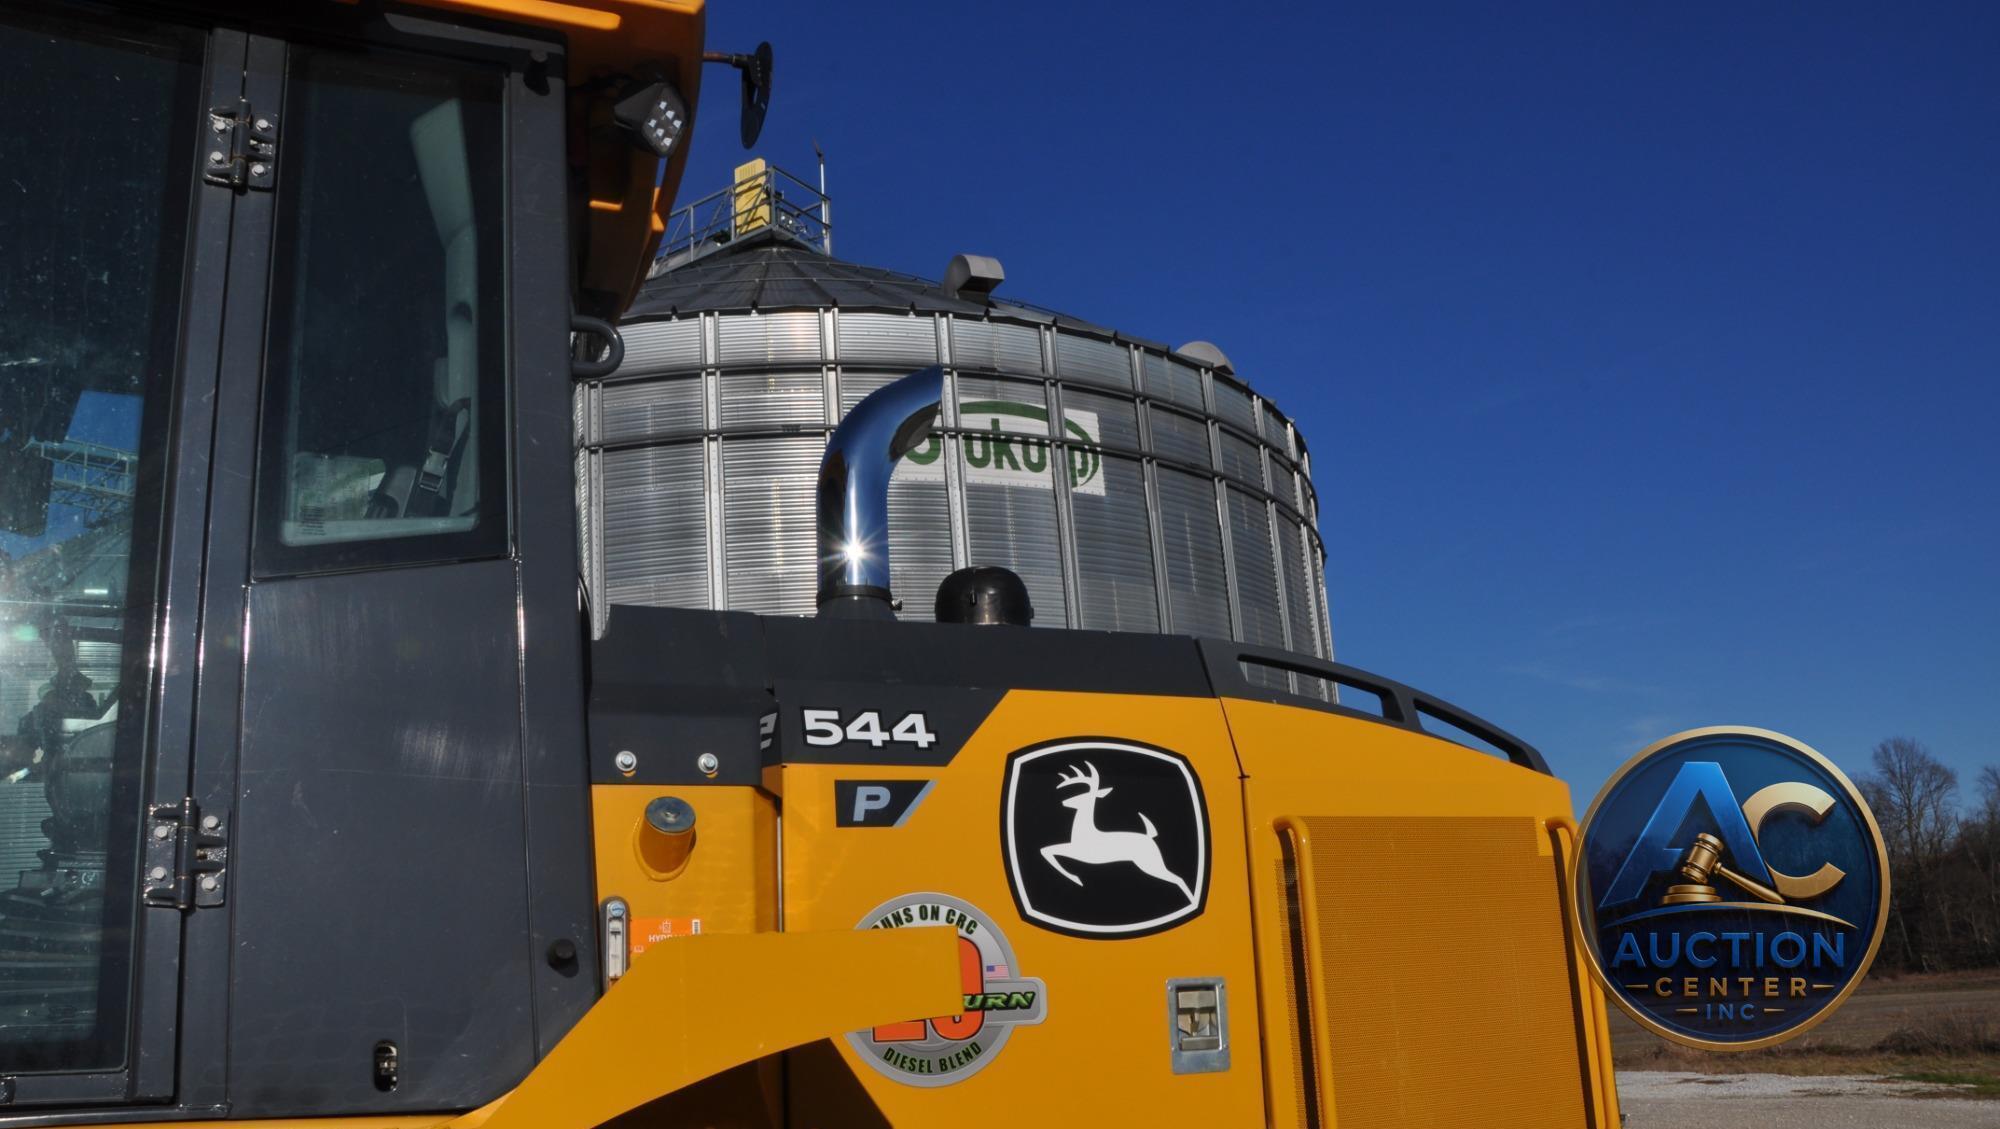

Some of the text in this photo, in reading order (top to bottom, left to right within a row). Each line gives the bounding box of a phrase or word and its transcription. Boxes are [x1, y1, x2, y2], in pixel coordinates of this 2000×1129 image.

[804, 709, 936, 748] 544
[853, 786, 891, 822] P
[871, 904, 978, 935] UNS ON CRC
[963, 992, 1035, 1014] URN
[883, 1041, 983, 1073] DIESEL BLEND
